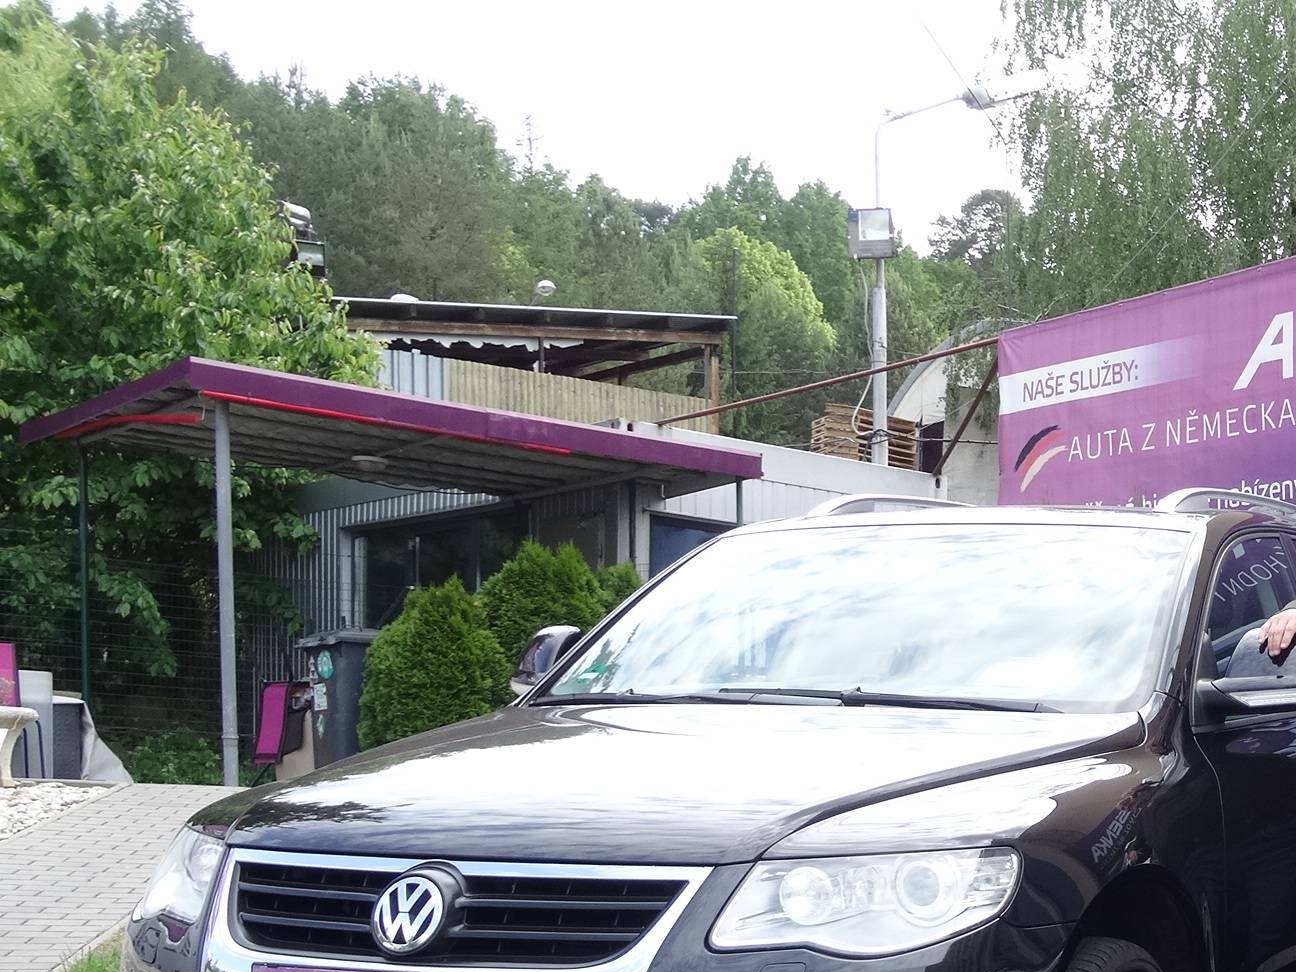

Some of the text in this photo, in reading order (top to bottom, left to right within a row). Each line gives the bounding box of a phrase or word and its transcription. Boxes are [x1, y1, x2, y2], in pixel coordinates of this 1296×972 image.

[1022, 360, 1139, 402] NAŠE SLUŽBY:
[1068, 427, 1133, 462] AUTA
[1141, 423, 1156, 451] Z
[1166, 399, 1296, 447] NĚMECKA
